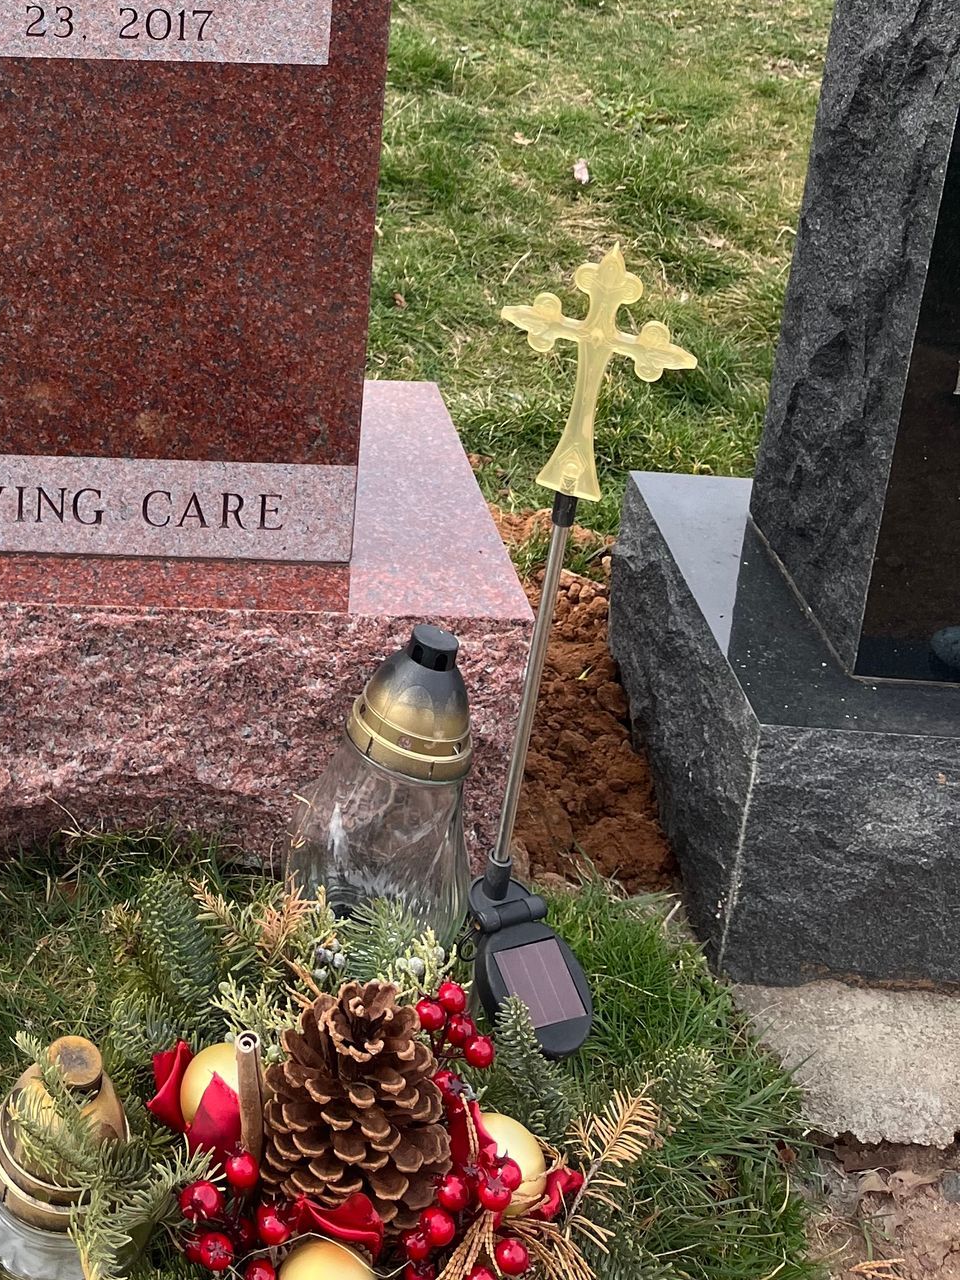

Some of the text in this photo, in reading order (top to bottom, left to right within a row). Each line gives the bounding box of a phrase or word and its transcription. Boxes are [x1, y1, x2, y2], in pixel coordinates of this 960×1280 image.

[25, 5, 88, 42] 23,
[118, 7, 214, 43] 2017
[141, 489, 284, 531] CARE
